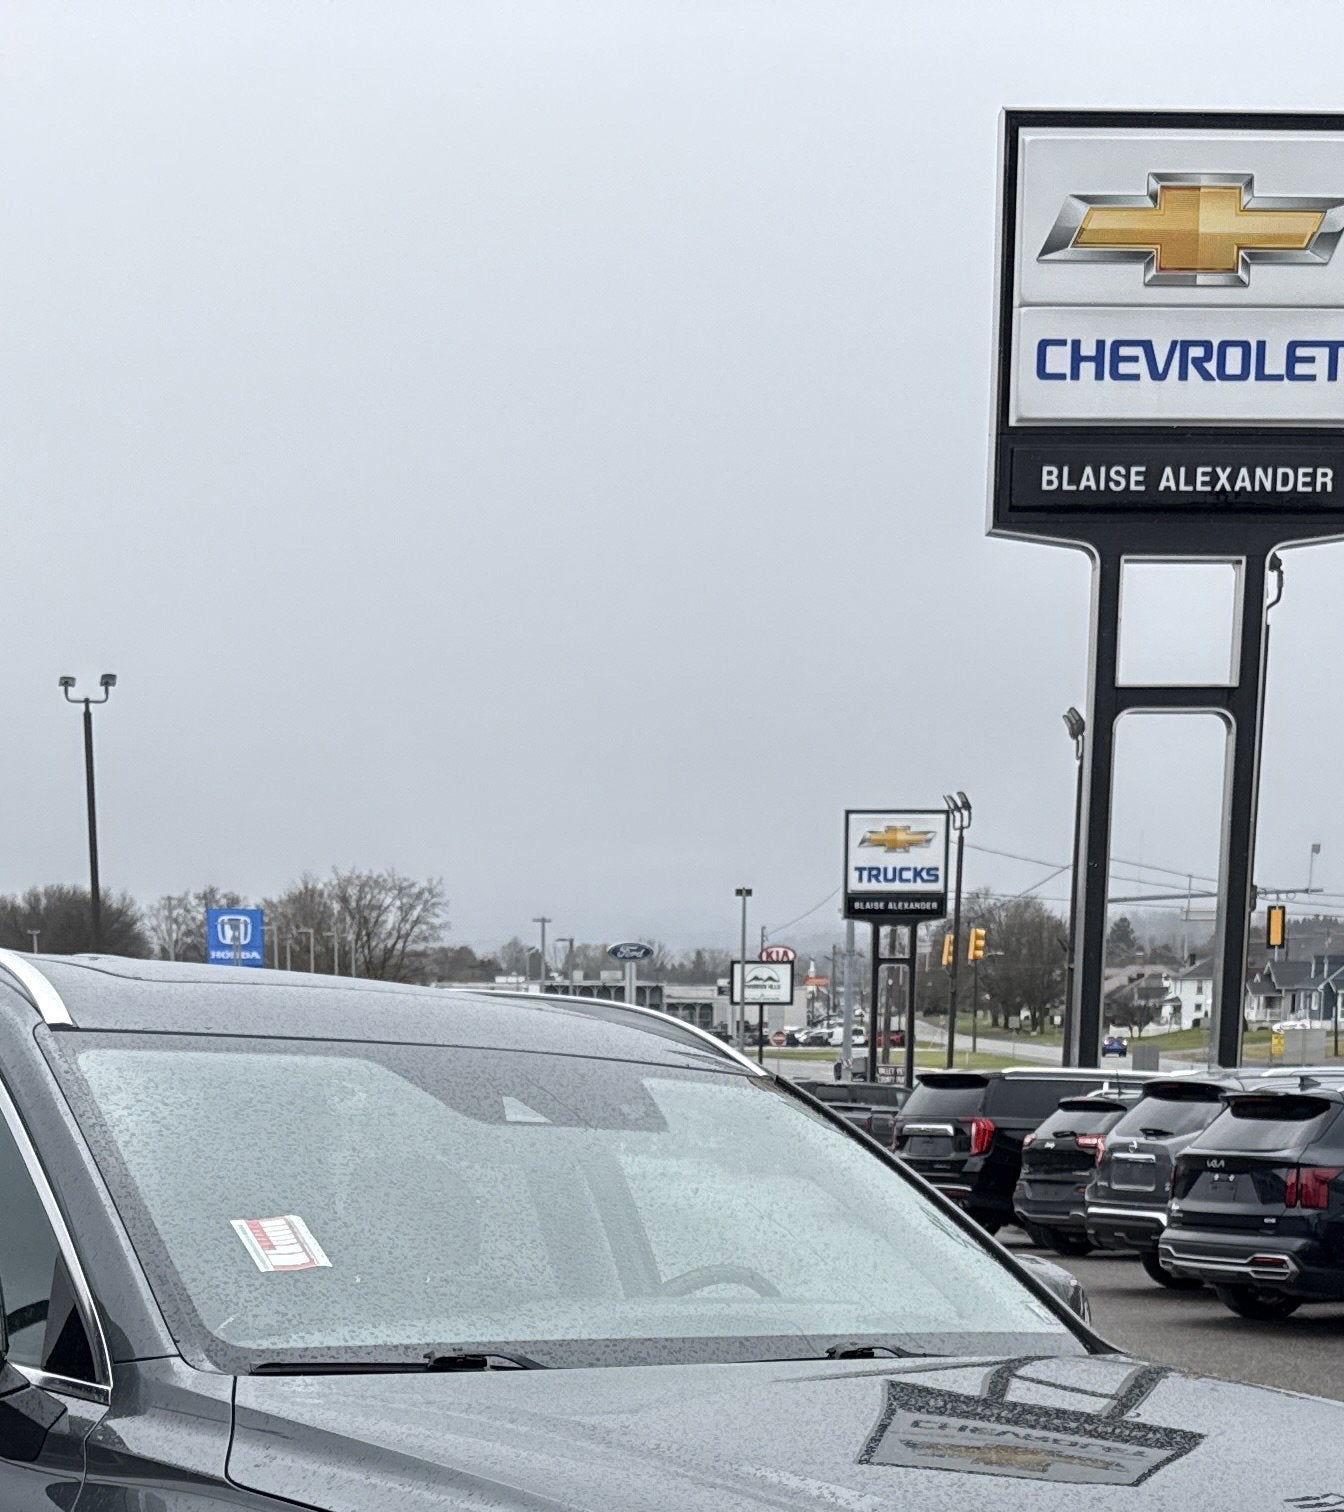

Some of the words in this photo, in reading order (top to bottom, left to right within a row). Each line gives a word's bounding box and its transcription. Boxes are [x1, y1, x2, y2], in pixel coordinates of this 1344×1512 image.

[1041, 466, 1146, 492] BLAISE
[1159, 466, 1334, 493] ALEXANDER
[854, 867, 939, 883] TRUCKS
[854, 901, 885, 910] BLAISE
[887, 901, 938, 910] ALEXANDER
[765, 950, 790, 961] KIA
